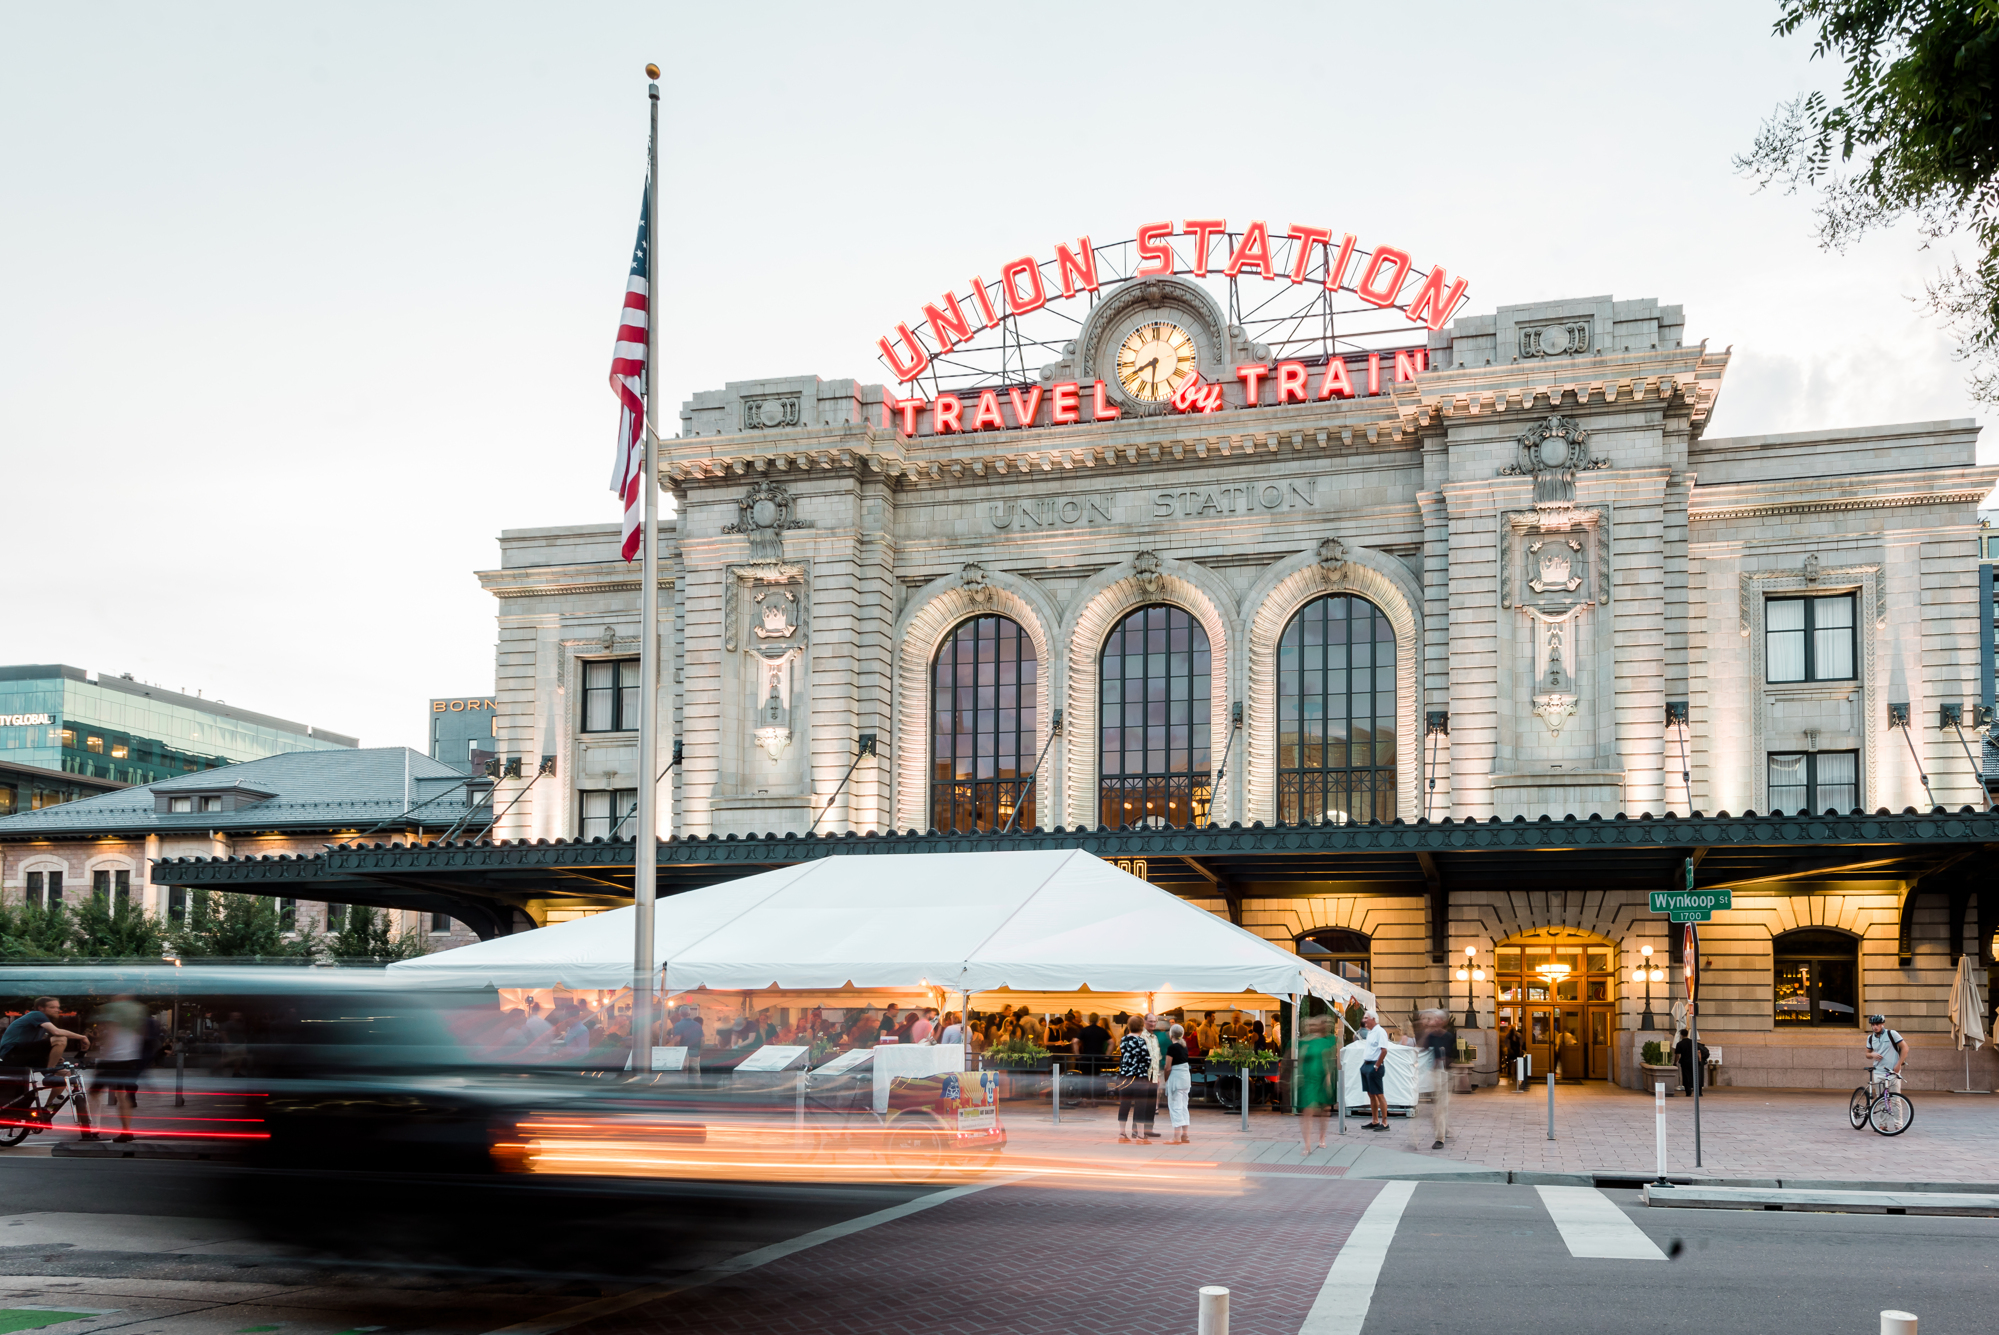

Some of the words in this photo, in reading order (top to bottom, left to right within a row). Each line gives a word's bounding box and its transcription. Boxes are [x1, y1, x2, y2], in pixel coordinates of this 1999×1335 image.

[876, 235, 1099, 383] UNION
[1136, 218, 1469, 331] STATION
[895, 380, 1122, 438] TRAVEL
[1170, 370, 1224, 414] by
[1236, 348, 1428, 407] TRAIN
[990, 497, 1114, 529] UNION
[1154, 480, 1316, 517] STATION
[433, 699, 497, 712] BORN
[12, 713, 52, 726] GLOBAL
[1655, 893, 1715, 909] Wynkoop
[1719, 895, 1729, 904] St
[1680, 912, 1702, 920] 1700
